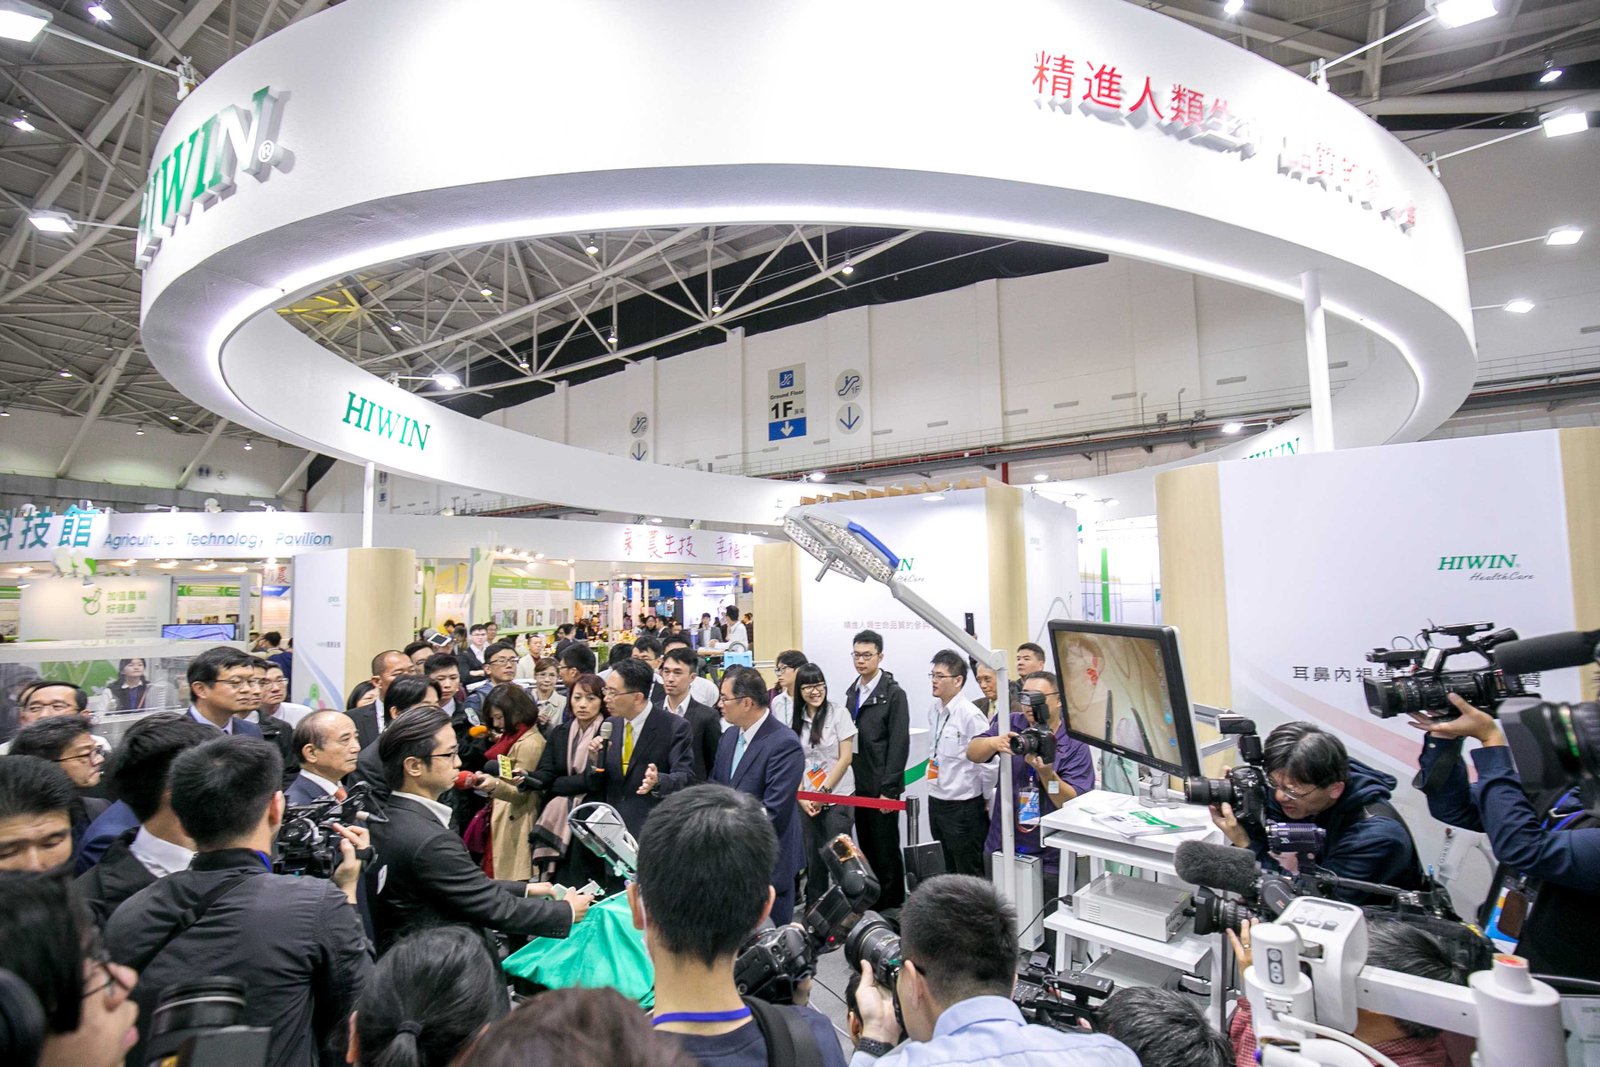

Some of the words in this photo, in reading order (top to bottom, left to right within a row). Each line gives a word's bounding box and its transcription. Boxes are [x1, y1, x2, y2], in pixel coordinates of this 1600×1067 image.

[771, 400, 793, 419] 1F
[342, 391, 431, 451] HIWIN
[276, 531, 333, 546] Pavilion
[1437, 553, 1518, 571] HIWIN
[1469, 571, 1535, 581] HealthCare
